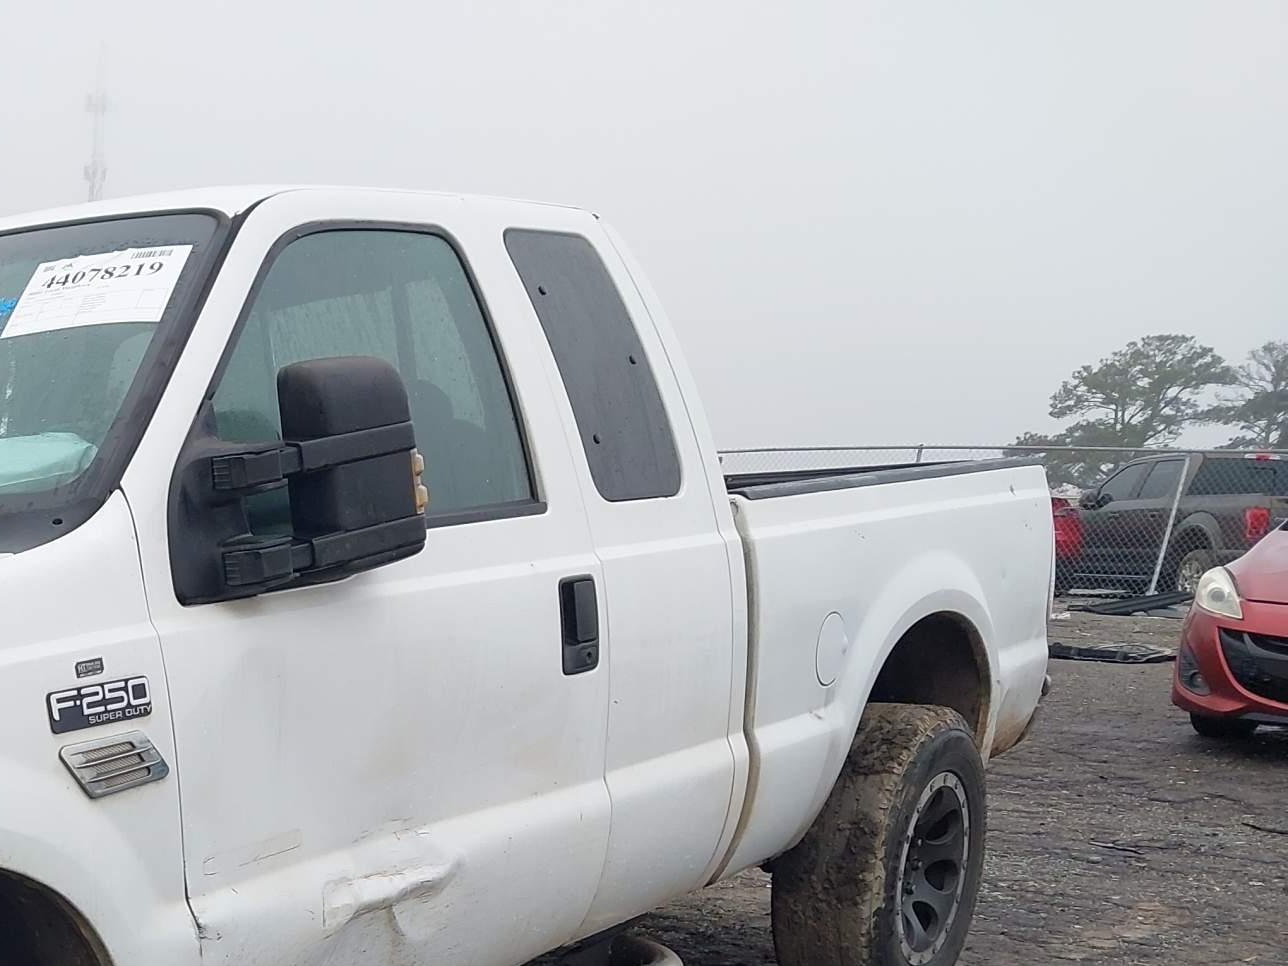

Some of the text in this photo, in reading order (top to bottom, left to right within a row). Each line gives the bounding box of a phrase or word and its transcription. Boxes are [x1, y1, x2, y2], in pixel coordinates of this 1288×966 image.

[42, 261, 164, 288] 44078219
[50, 677, 151, 721] F-250
[88, 704, 152, 725] SUPER DUTY
